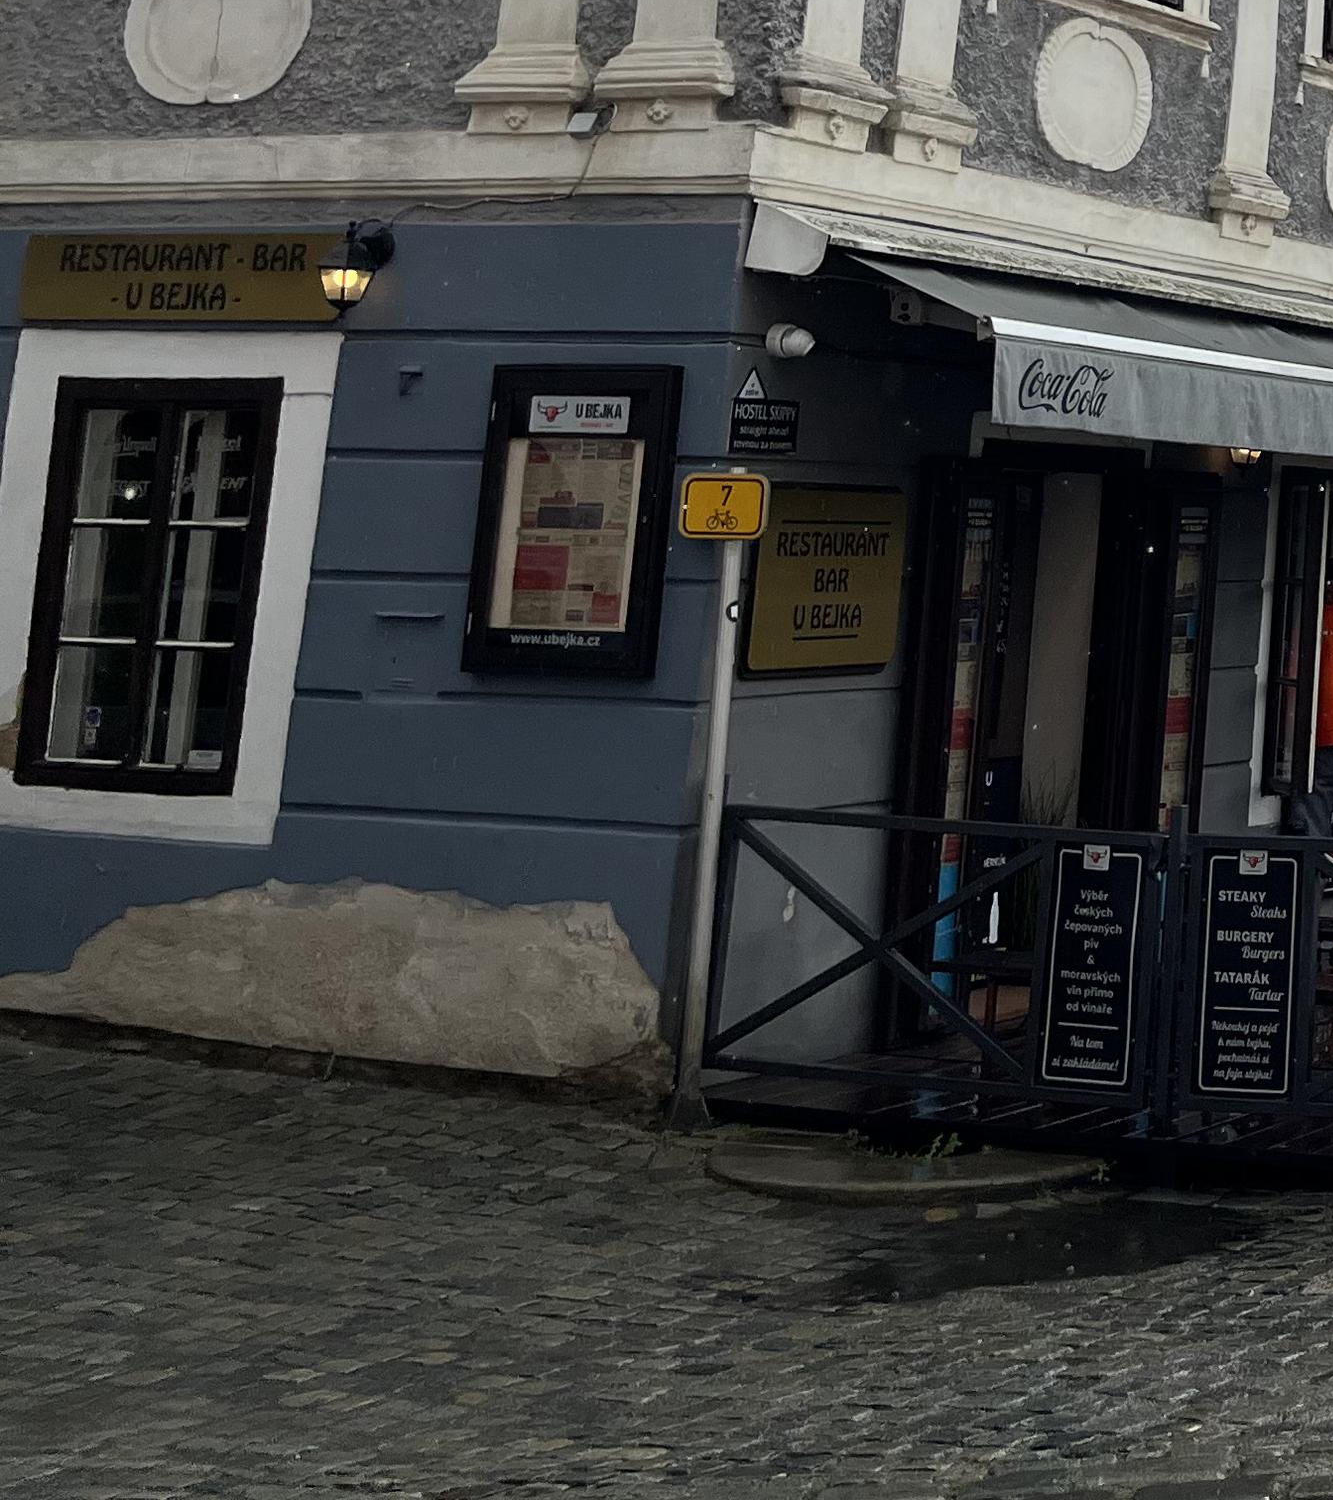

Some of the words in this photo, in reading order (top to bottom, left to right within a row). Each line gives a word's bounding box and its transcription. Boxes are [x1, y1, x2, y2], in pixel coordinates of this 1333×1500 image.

[60, 243, 231, 272] RESTAURANT
[252, 243, 308, 272] BAR
[126, 283, 143, 310] U
[149, 283, 227, 311] BEJKA
[576, 403, 583, 418] U
[585, 403, 622, 419] BEJKA
[734, 404, 768, 420] HOSTEL
[721, 485, 733, 506] 7
[776, 532, 891, 557] RESTAURANT
[814, 568, 850, 593] BAR
[793, 605, 806, 631] U
[810, 603, 862, 629] BEJKA
[510, 632, 601, 649] www.ubejka.cz
[1080, 888, 1109, 902] Výběr
[1218, 890, 1266, 903] STEAKY
[1074, 904, 1114, 919] českých
[1250, 904, 1287, 919] Steaks
[1064, 919, 1123, 937] čepovaných
[1084, 937, 1099, 951] piv
[1216, 930, 1274, 943] BURGERY
[1241, 945, 1285, 963] Burgers
[1060, 970, 1121, 984] moravských
[1214, 969, 1270, 985] TATARÁK
[1248, 987, 1285, 1001] Tartar
[1066, 1001, 1079, 1012] od
[1081, 1002, 1113, 1014] vinaře
